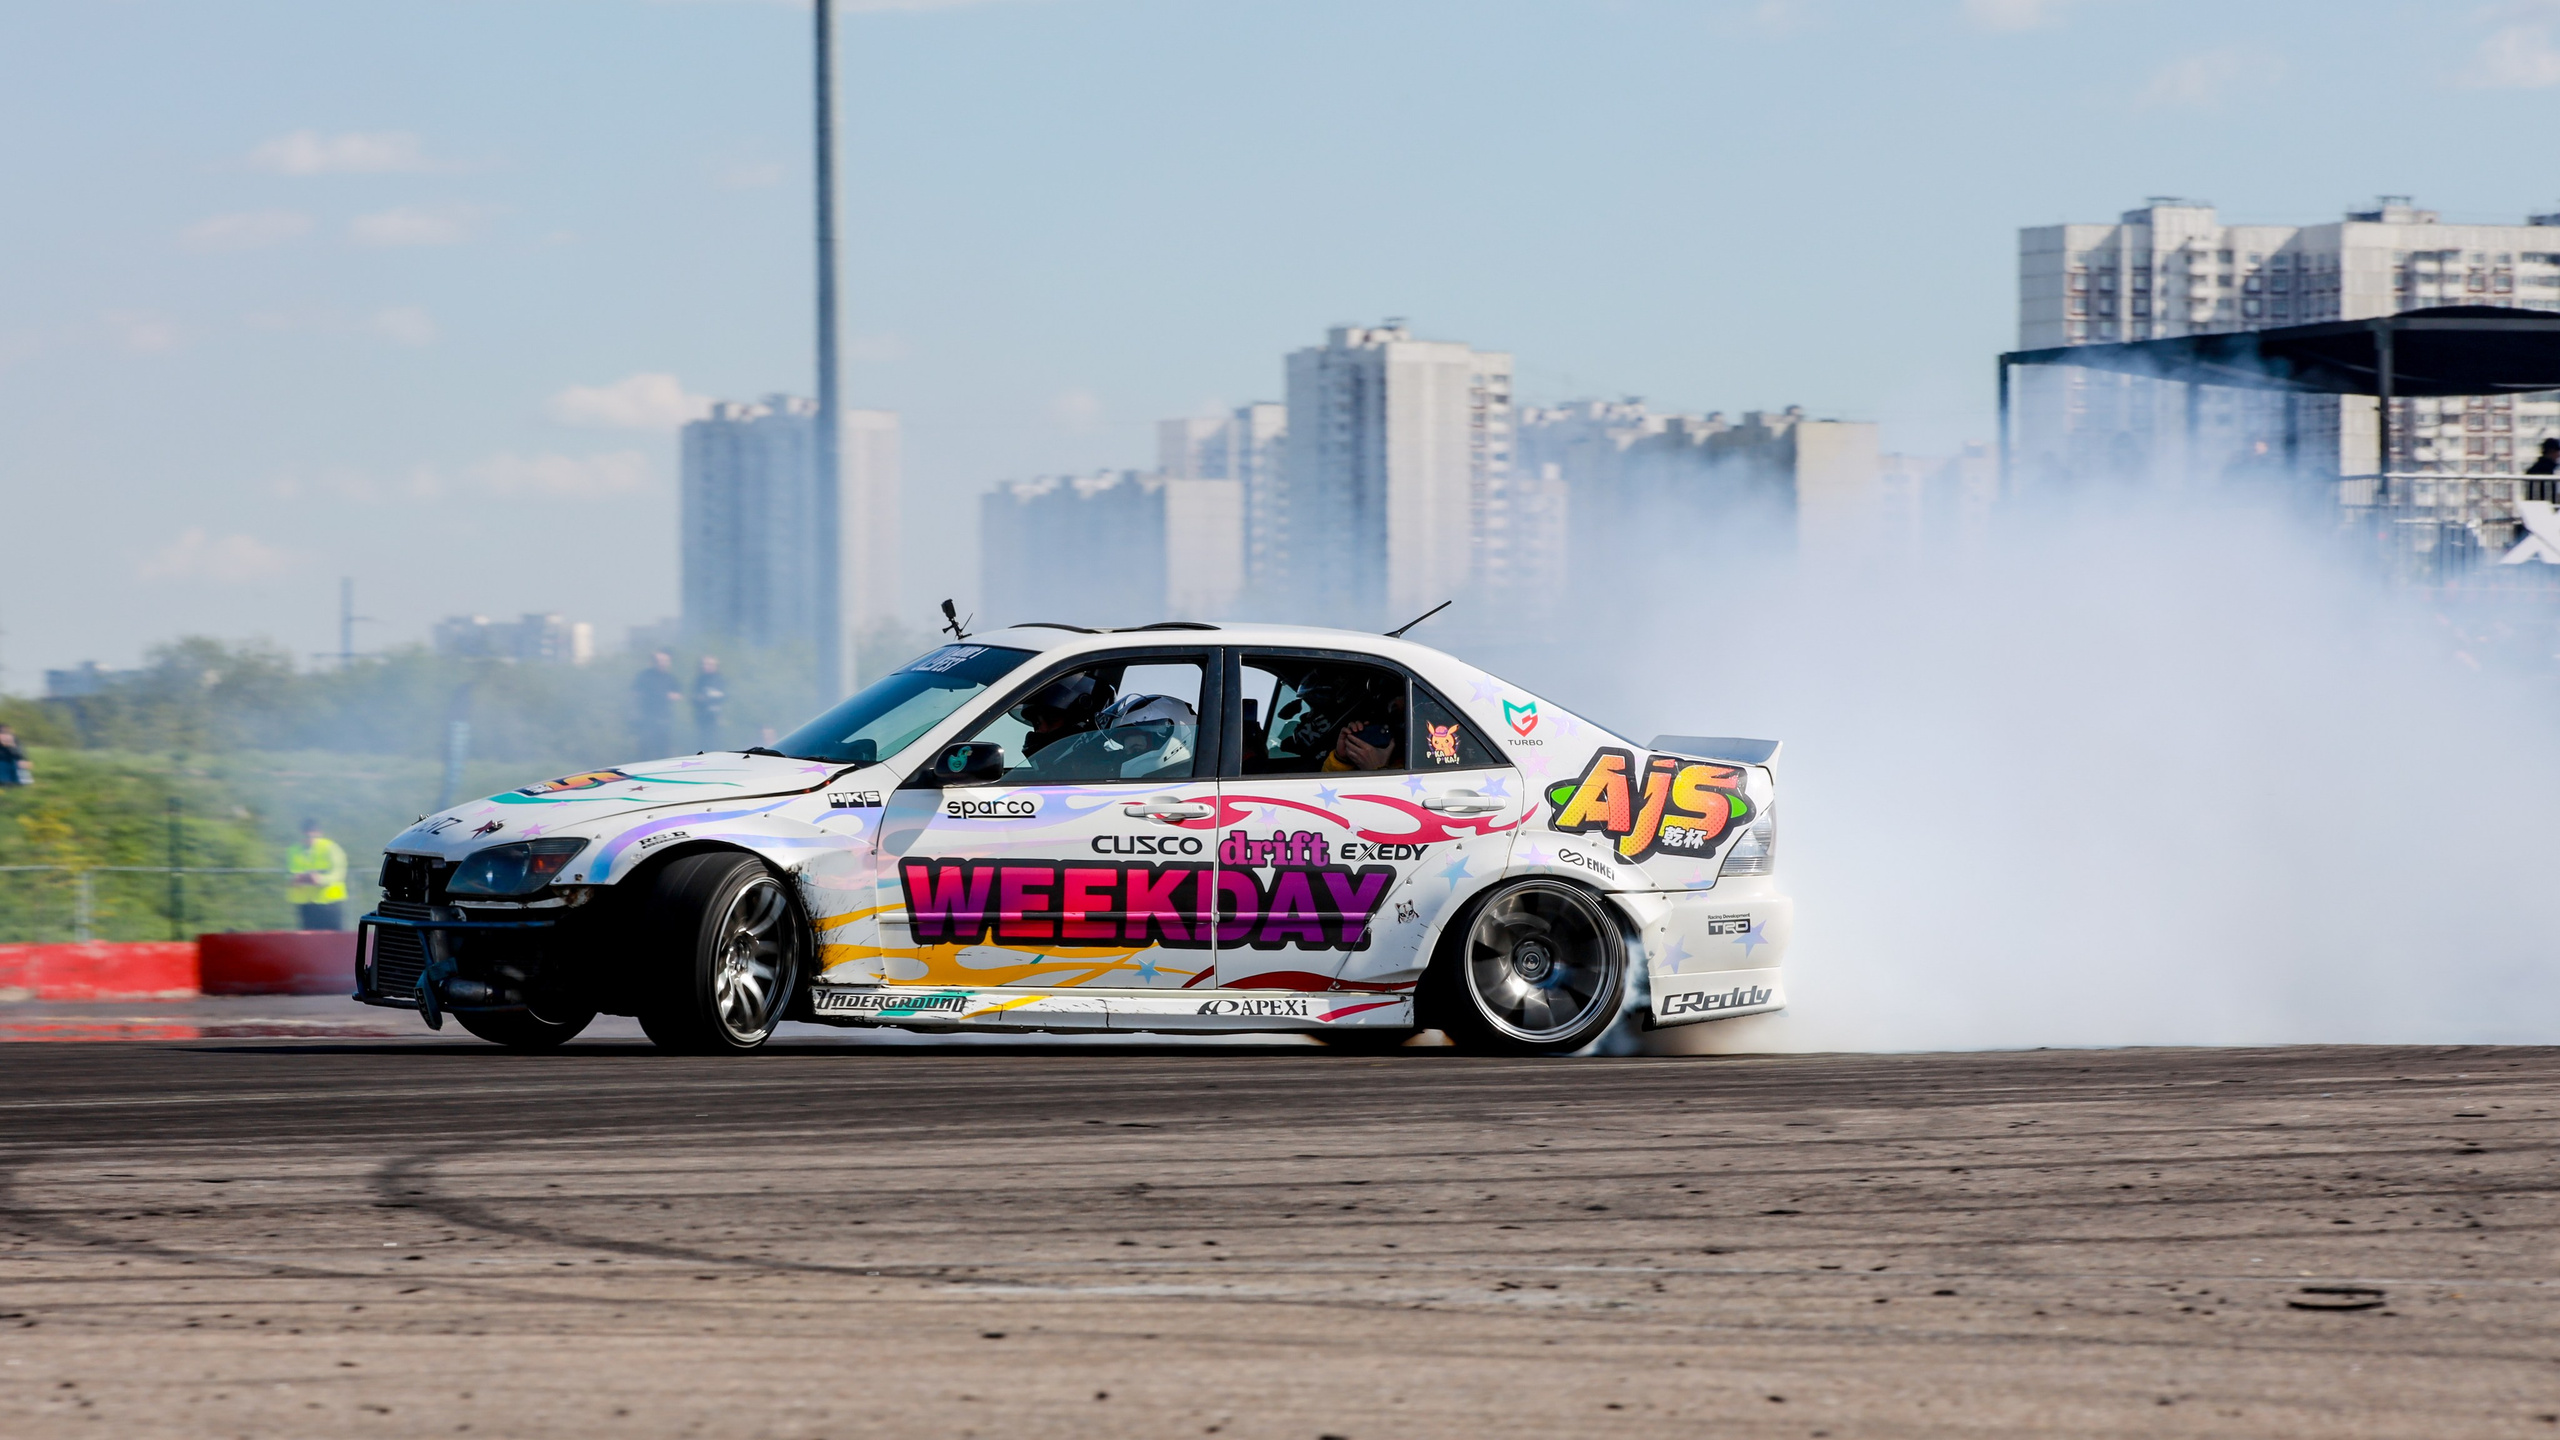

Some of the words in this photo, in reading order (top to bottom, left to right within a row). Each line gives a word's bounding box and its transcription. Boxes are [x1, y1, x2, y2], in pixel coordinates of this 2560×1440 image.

[827, 790, 882, 808] HKS
[946, 801, 1036, 819] sparco
[1091, 836, 1203, 855] CUSCO
[1661, 826, 1708, 849] 乾杯
[1219, 830, 1330, 868] drift
[1340, 842, 1430, 862] EXEDY
[903, 862, 1393, 945] WEEKDAY
[1709, 919, 1750, 935] TRD
[814, 989, 969, 1012] UNDERGROUND
[1660, 985, 1773, 1015] GReddy
